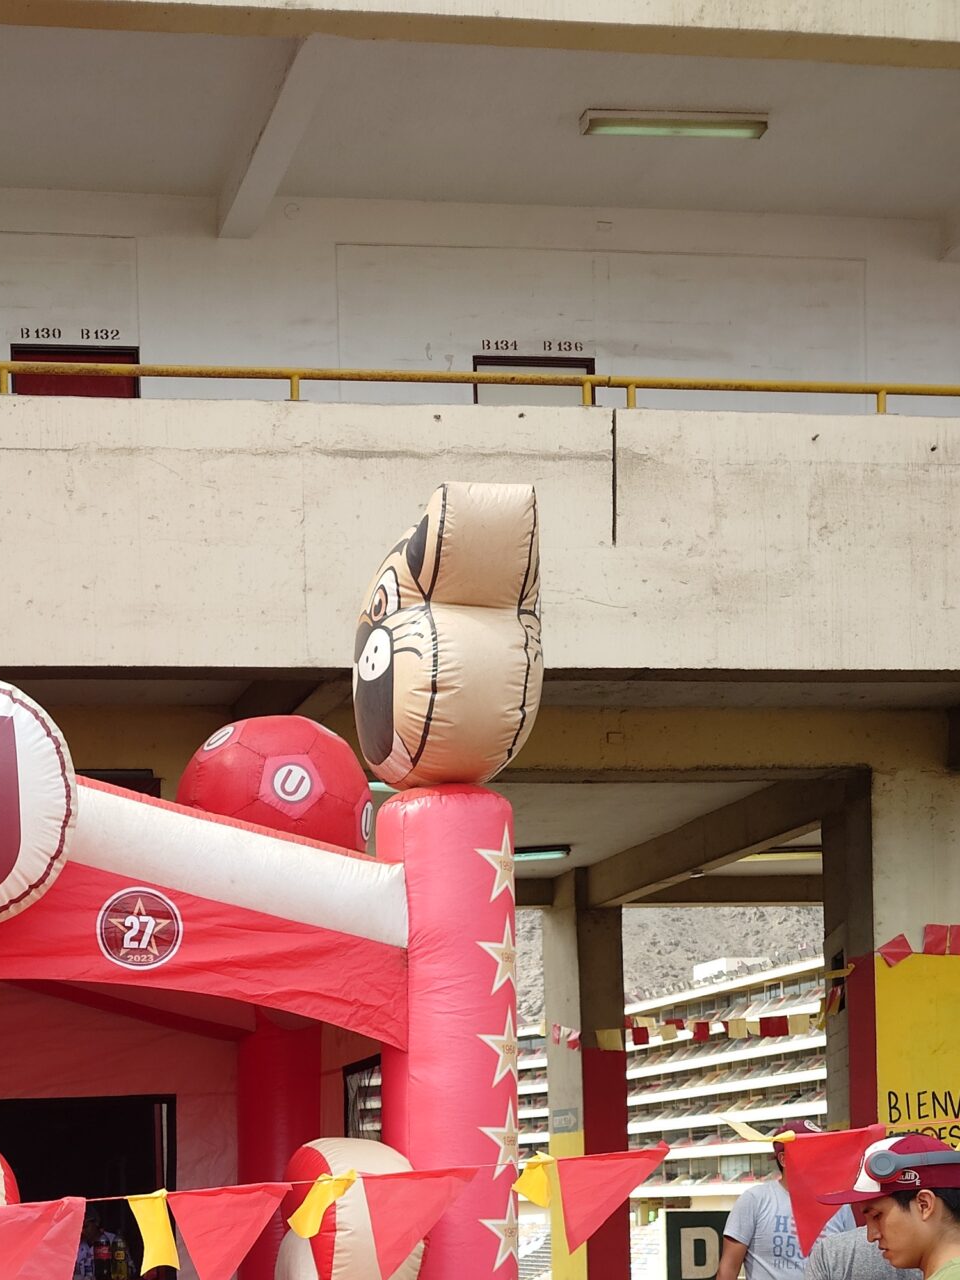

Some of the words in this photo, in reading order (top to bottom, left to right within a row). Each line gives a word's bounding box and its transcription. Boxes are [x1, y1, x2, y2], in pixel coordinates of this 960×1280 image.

[35, 328, 61, 338] 130
[94, 329, 120, 340] 132
[495, 340, 518, 351] 134
[557, 341, 583, 351] 136
[280, 768, 305, 797] U
[123, 915, 156, 949] 27
[127, 954, 154, 962] 2023
